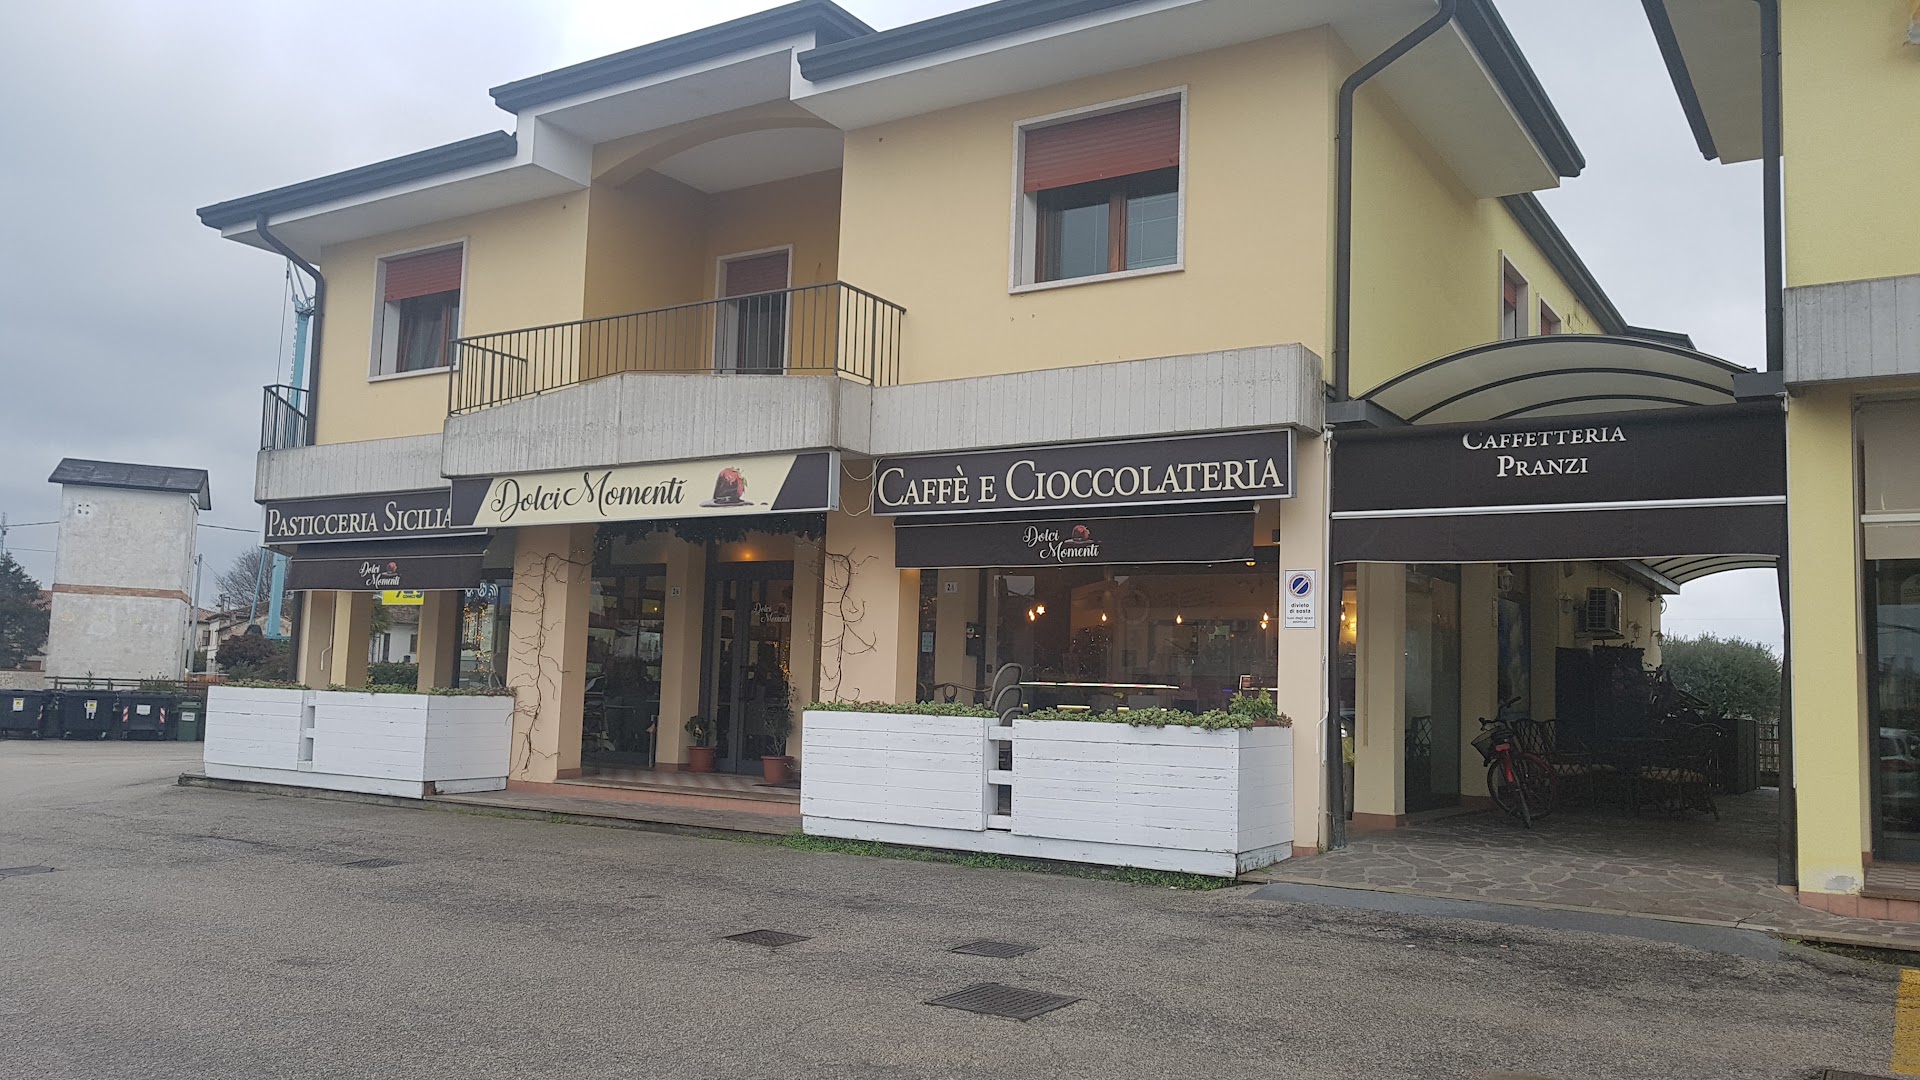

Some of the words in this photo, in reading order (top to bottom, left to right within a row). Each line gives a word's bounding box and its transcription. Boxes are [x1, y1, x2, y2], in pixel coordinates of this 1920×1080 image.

[1462, 426, 1627, 450] CAFFETTERIA
[1497, 455, 1589, 478] PRANZI
[877, 464, 970, 508] CAFFÈ
[977, 474, 998, 504] E
[1005, 456, 1285, 502] CIOCCOLATERIA
[490, 478, 562, 522] Dolci
[563, 470, 687, 517] Momenti
[266, 508, 379, 537] PASTICCERIA
[1022, 525, 1060, 548] Dolci
[1039, 541, 1100, 563] Momenti
[358, 561, 381, 578] Dolci
[365, 573, 400, 589] Momenti
